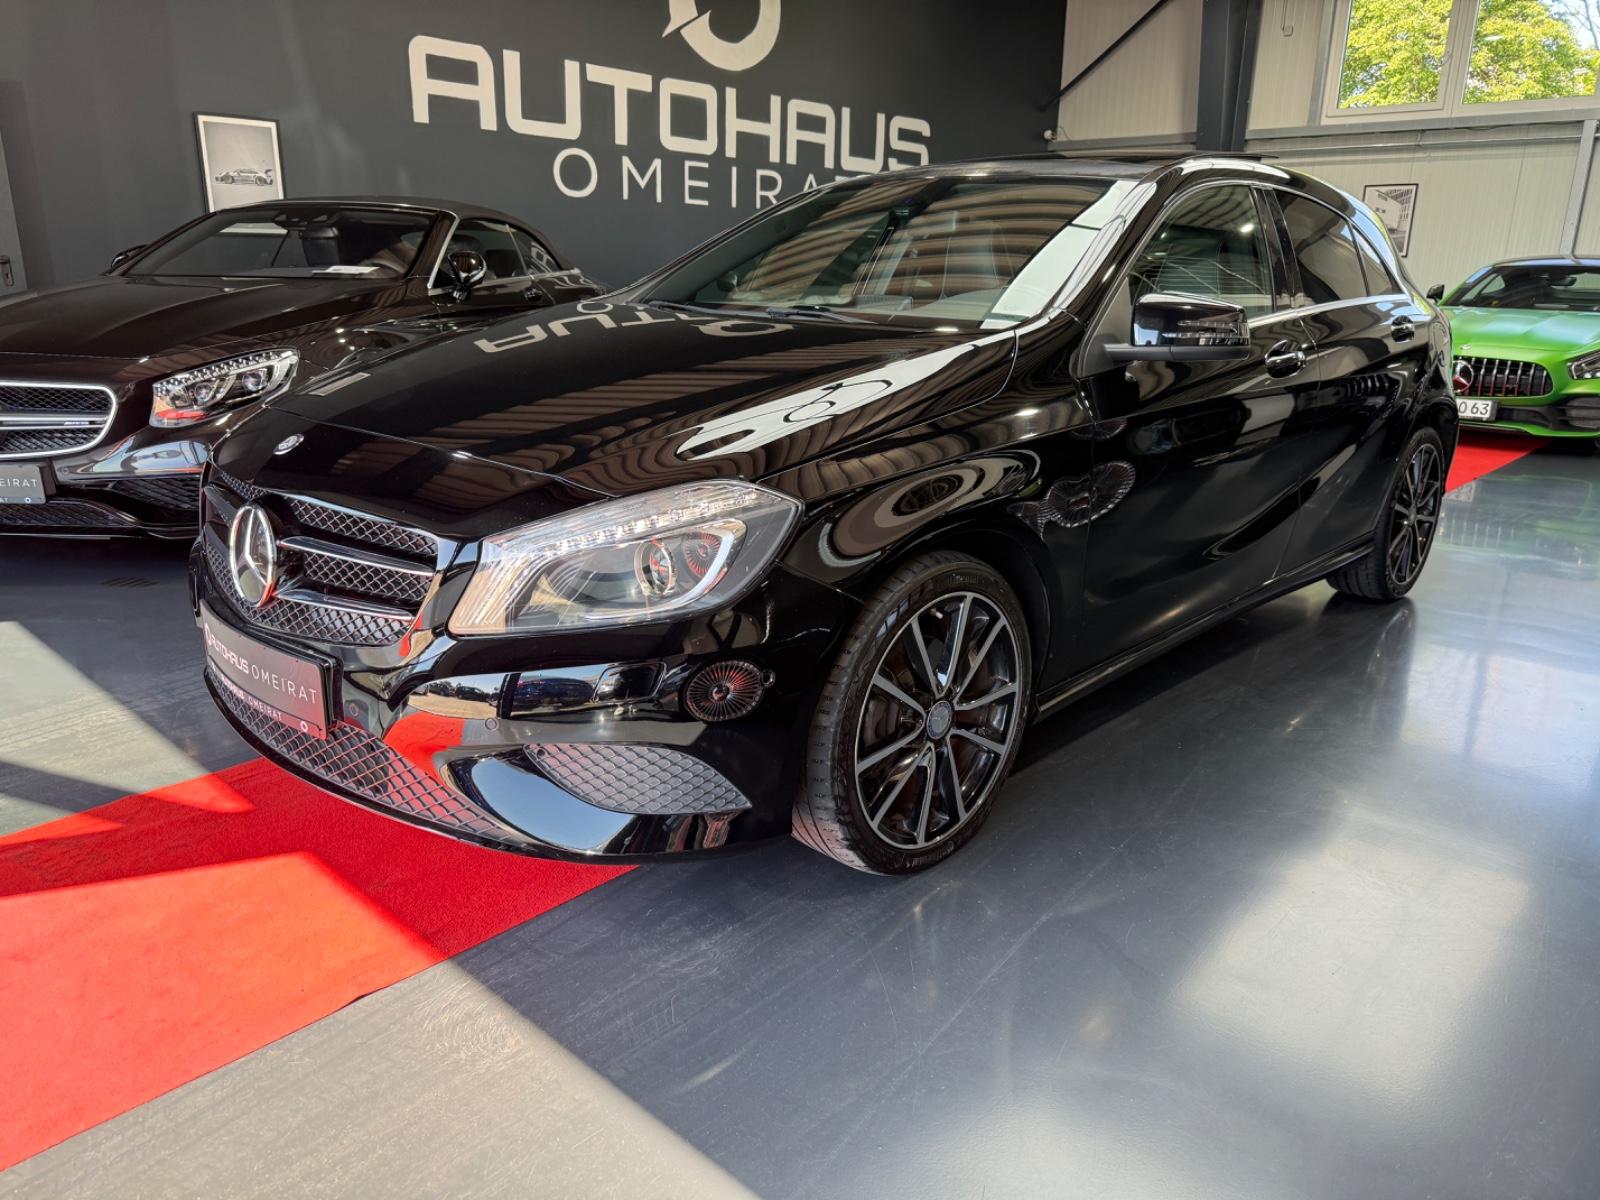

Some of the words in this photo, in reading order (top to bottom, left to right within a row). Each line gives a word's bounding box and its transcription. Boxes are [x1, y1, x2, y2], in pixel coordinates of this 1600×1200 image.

[408, 35, 930, 174] AUTOHAUS
[553, 147, 850, 209] OMEIRA
[1470, 403, 1490, 415] 63
[251, 664, 317, 704] OMEIRAT
